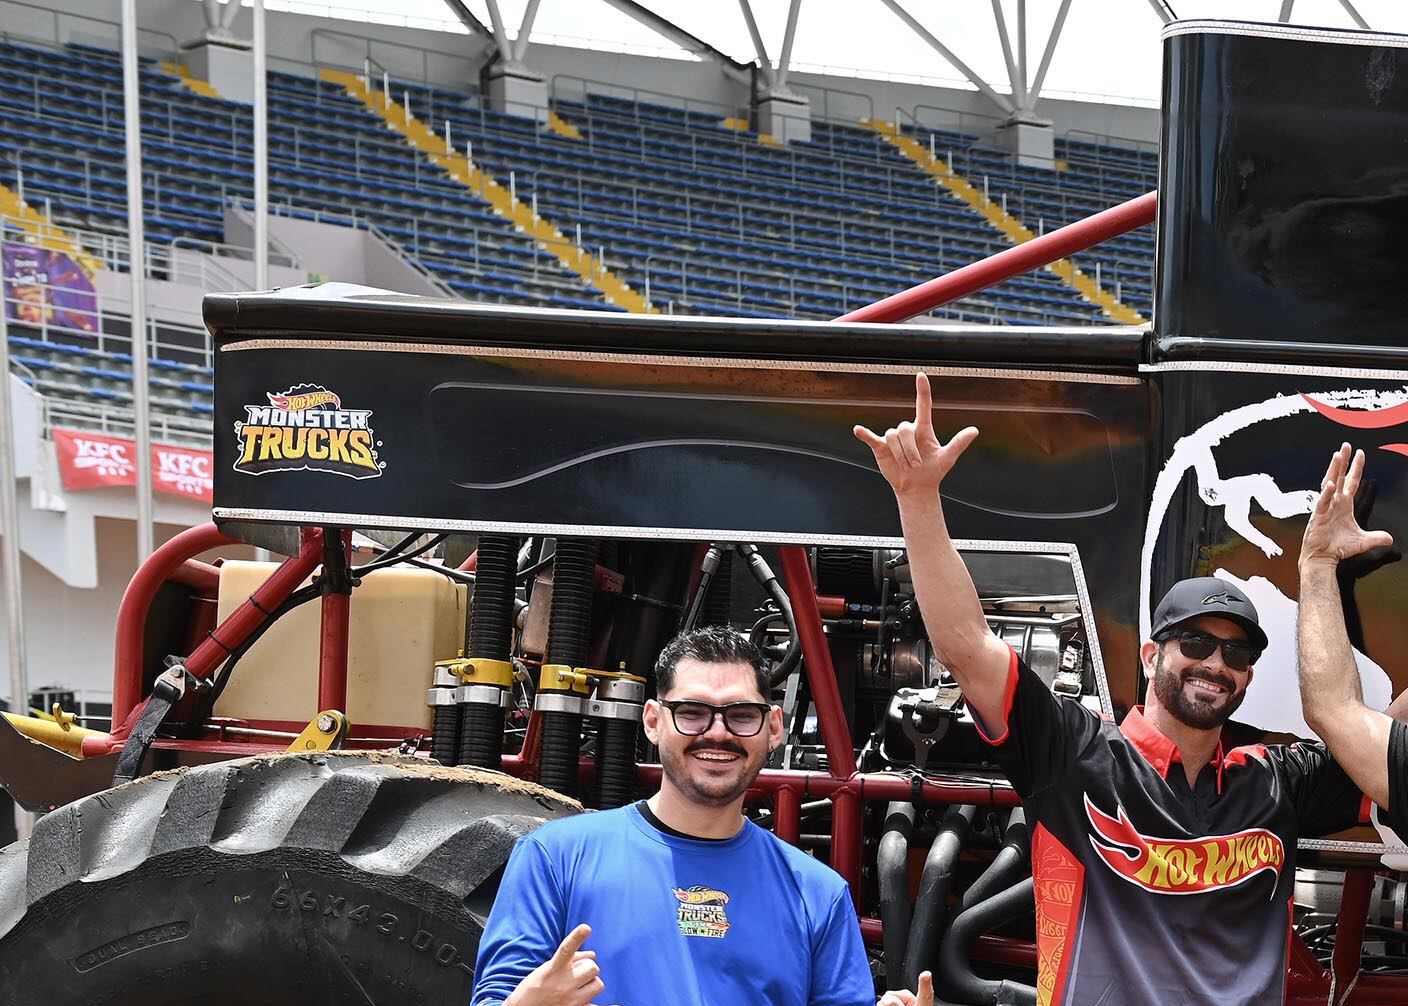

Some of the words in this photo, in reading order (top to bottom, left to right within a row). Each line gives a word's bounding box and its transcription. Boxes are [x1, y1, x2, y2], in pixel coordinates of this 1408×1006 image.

[249, 407, 368, 429] MONSTER
[73, 438, 130, 464] KFC
[238, 425, 378, 470] TRUCKS
[158, 451, 210, 478] KFC
[678, 908, 727, 923] TRUCKS
